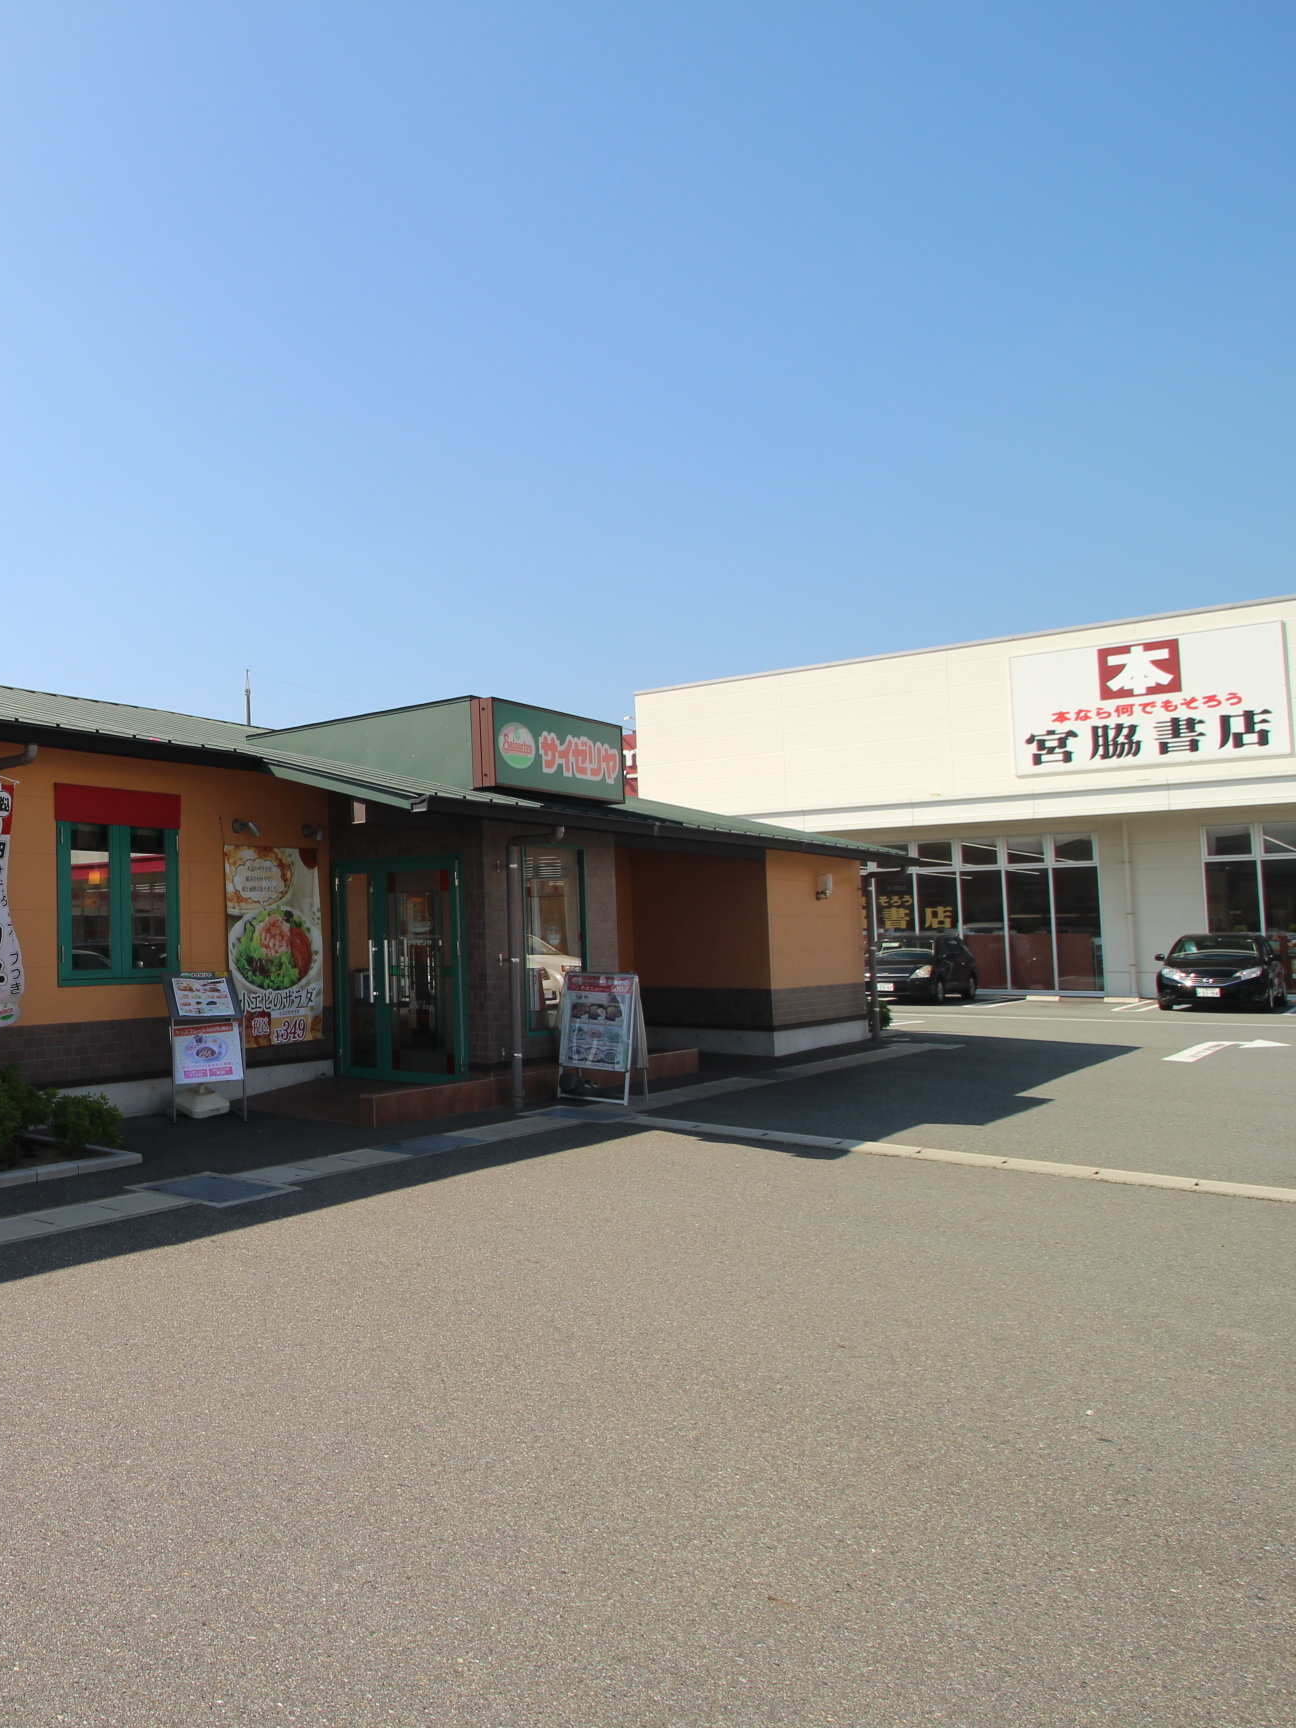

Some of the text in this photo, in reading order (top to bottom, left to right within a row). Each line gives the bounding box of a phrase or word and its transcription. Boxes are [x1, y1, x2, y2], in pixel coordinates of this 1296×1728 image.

[1106, 645, 1174, 695] 本
[1051, 692, 1243, 723] 本なら何でもそろう
[502, 734, 533, 755] Saizeriya
[1025, 709, 1273, 766] 宮脇書店
[540, 731, 619, 783] サイゼリヤ
[240, 986, 316, 1014] 小エビのサラダ
[275, 1018, 306, 1042] ¥349
